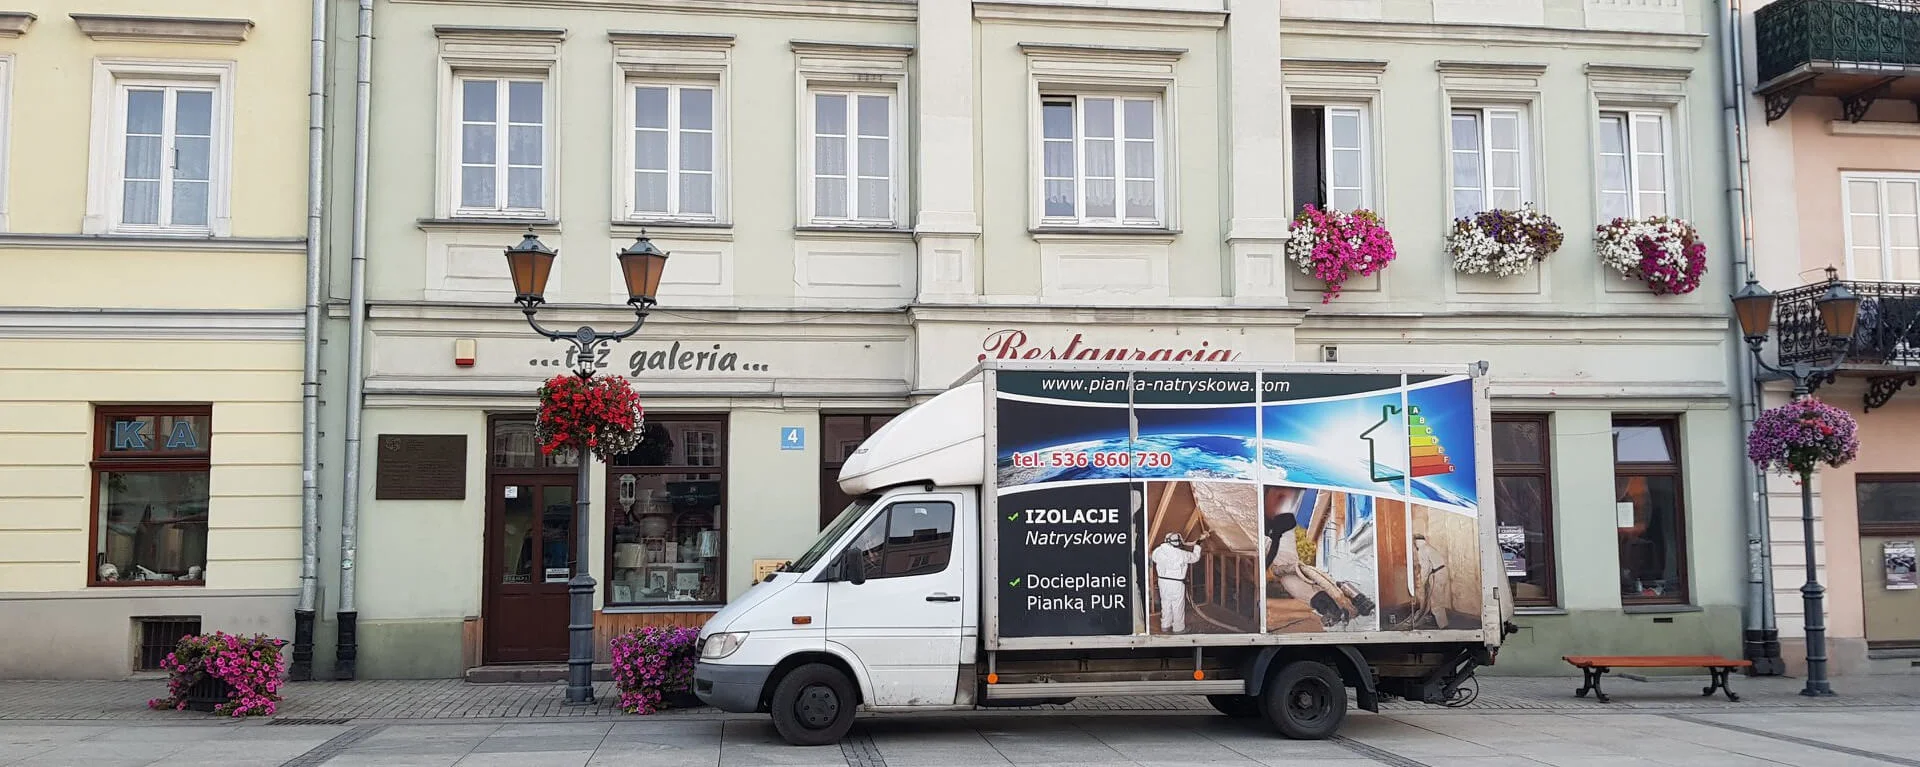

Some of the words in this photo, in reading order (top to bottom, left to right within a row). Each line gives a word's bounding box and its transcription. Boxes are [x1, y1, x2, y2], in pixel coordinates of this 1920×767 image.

[529, 341, 610, 368] ...tż
[629, 341, 768, 377] galeria...
[787, 428, 799, 443] 4
[1013, 452, 1045, 468] tel.
[1051, 452, 1088, 467] 536
[1093, 452, 1130, 467] 860
[1136, 452, 1172, 467] 730
[1025, 509, 1119, 524] IZOLACJE
[1025, 530, 1127, 548] Natryskowe
[1027, 573, 1126, 591] Docieplanie
[1027, 595, 1085, 613] Pianką
[1091, 594, 1126, 609] PUR
